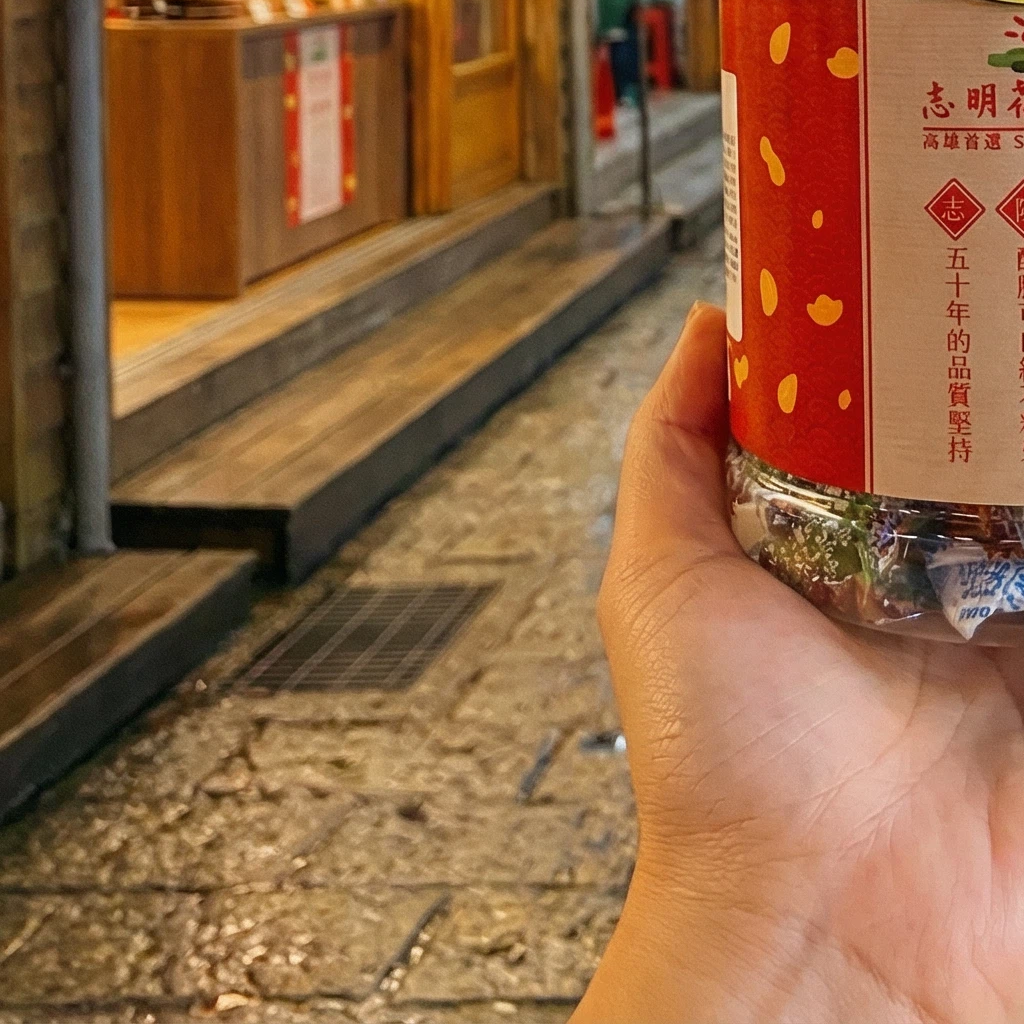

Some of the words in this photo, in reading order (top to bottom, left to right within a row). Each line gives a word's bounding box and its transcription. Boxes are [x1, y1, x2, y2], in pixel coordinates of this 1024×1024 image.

[941, 195, 966, 222] 志
[945, 246, 974, 464] 五十年的品質堅持
